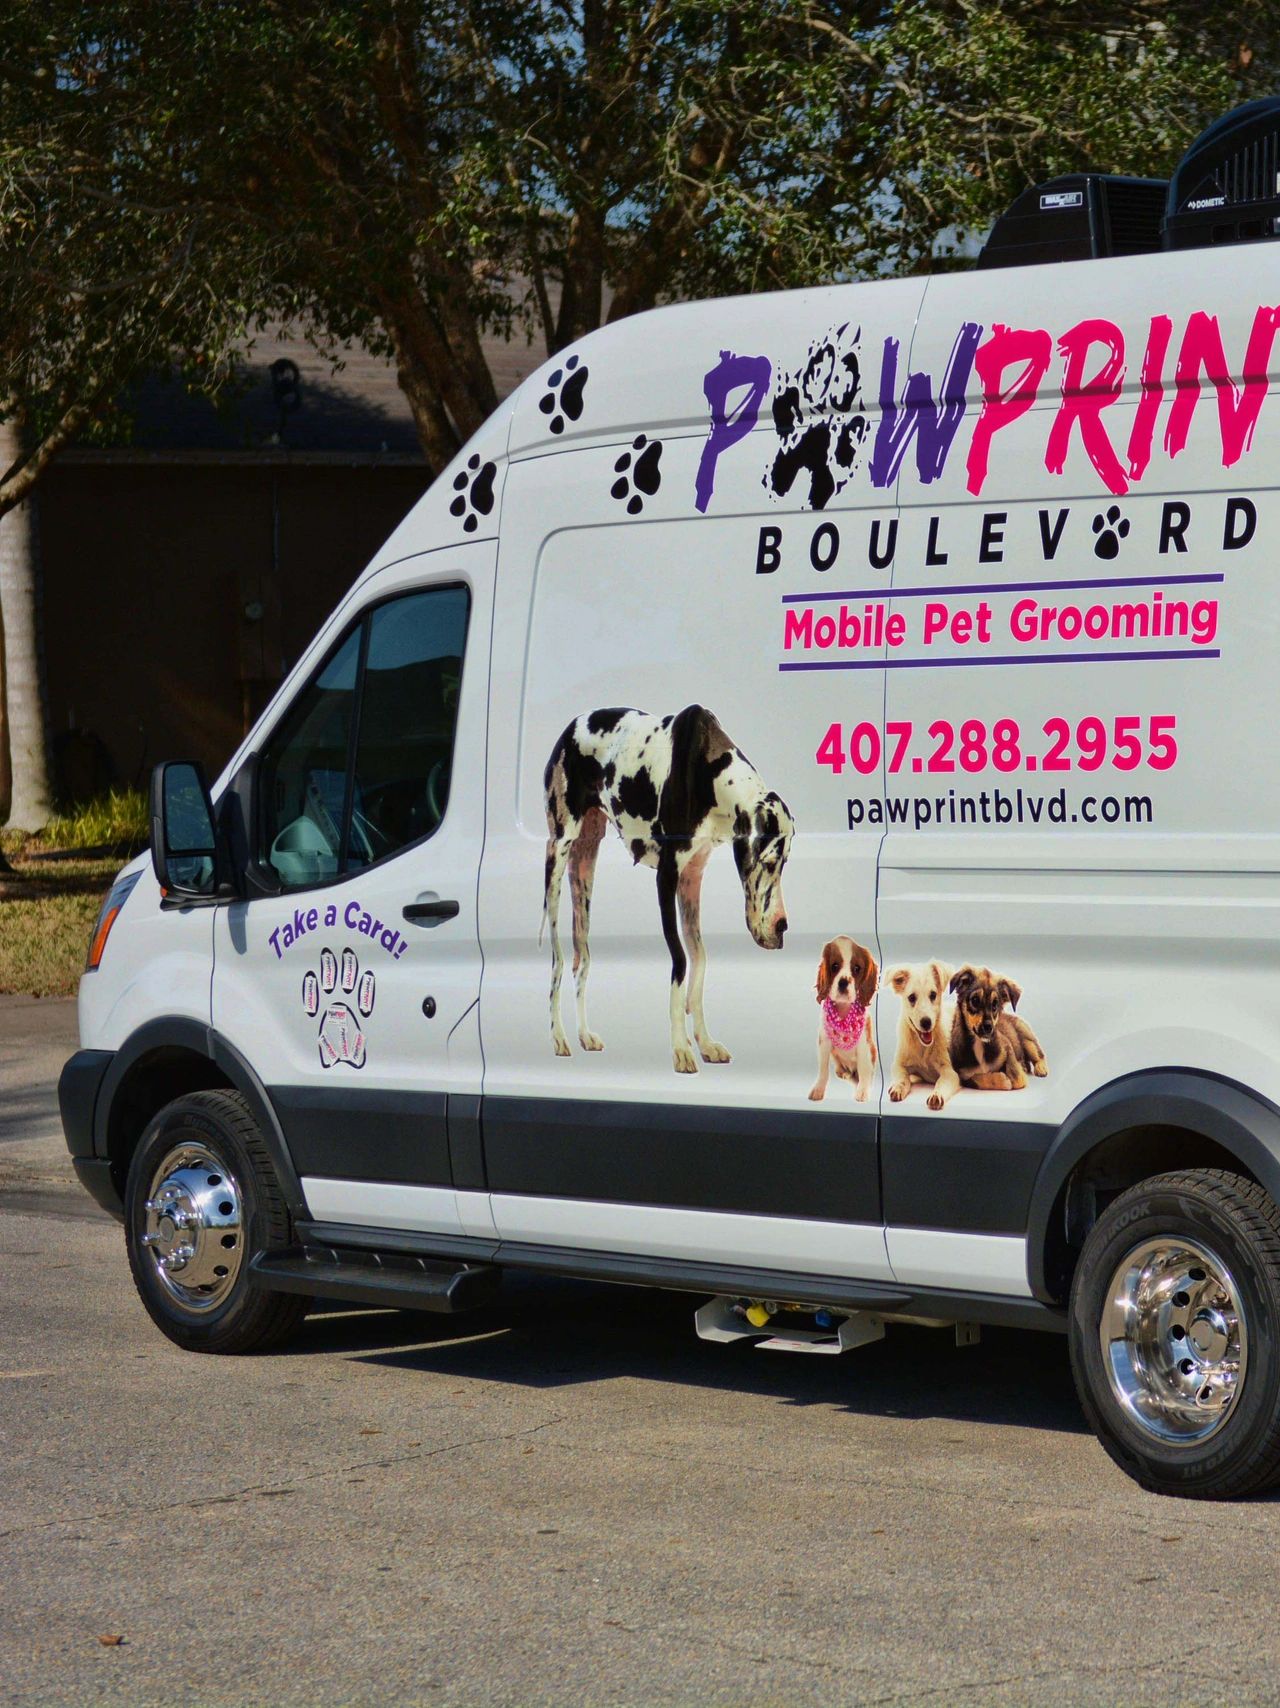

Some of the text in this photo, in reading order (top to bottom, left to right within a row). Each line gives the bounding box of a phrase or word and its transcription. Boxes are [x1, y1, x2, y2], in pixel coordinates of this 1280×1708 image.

[1196, 197, 1225, 209] DOMETIC
[755, 497, 1258, 575] BOULEVRD
[783, 591, 1220, 650] Mobile Pet Grooming
[815, 714, 1178, 775] 407.288.2955
[846, 787, 1154, 830] pawprintblvd.com
[267, 900, 409, 960] Take a Card!
